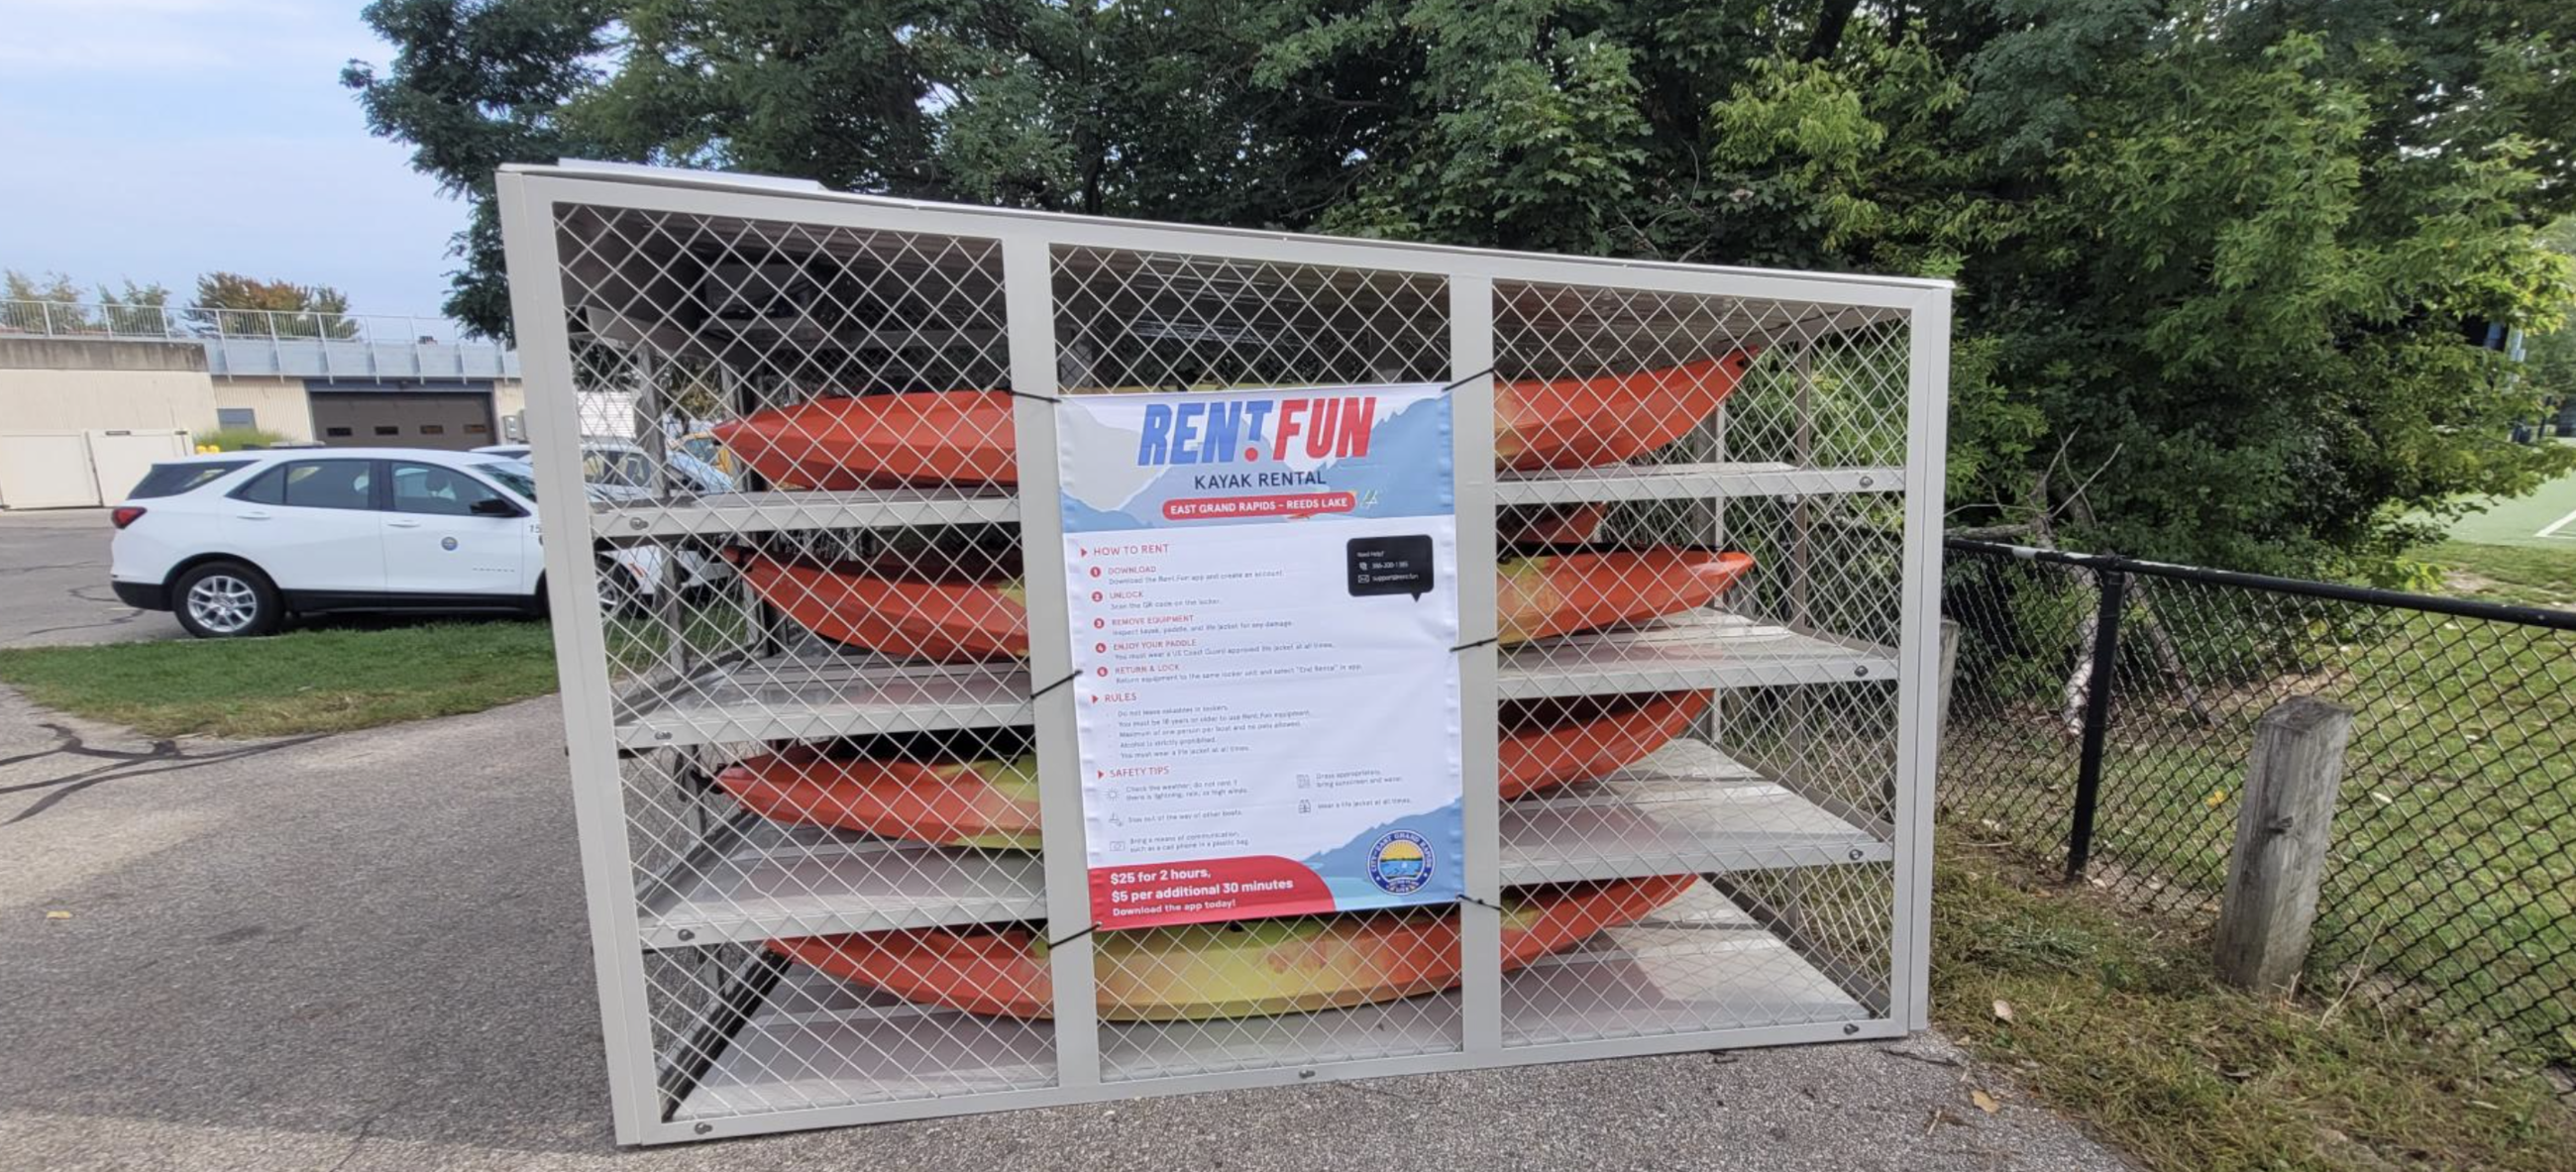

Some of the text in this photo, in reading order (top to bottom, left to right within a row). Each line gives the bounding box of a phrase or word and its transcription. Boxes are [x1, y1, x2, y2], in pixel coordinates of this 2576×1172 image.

[1137, 397, 1377, 467] RENT.FUN
[1194, 471, 1326, 490] KAYAK RENTAL
[1170, 503, 1198, 515] EAST
[1200, 502, 1236, 513] GRAND
[1238, 500, 1276, 512] RAPIDS
[1287, 499, 1319, 510] REEDS
[1321, 497, 1347, 508] LAKE
[1094, 544, 1169, 557] HOW TO RENT
[1108, 566, 1156, 575] DOWNLOAD
[1112, 615, 1194, 626] REMOVE EQUIPMENT
[1114, 642, 1139, 651] ENJOY
[1165, 639, 1197, 648] PADDLE
[1116, 666, 1146, 675] RETURN
[1105, 693, 1136, 703] RULES
[1110, 766, 1169, 778] SAFETY TIPS
[1110, 869, 1211, 885] $25 for 2 hours,
[1111, 880, 1294, 904] $5 per additional 30 minutes
[1113, 900, 1236, 916] Download the app today!
